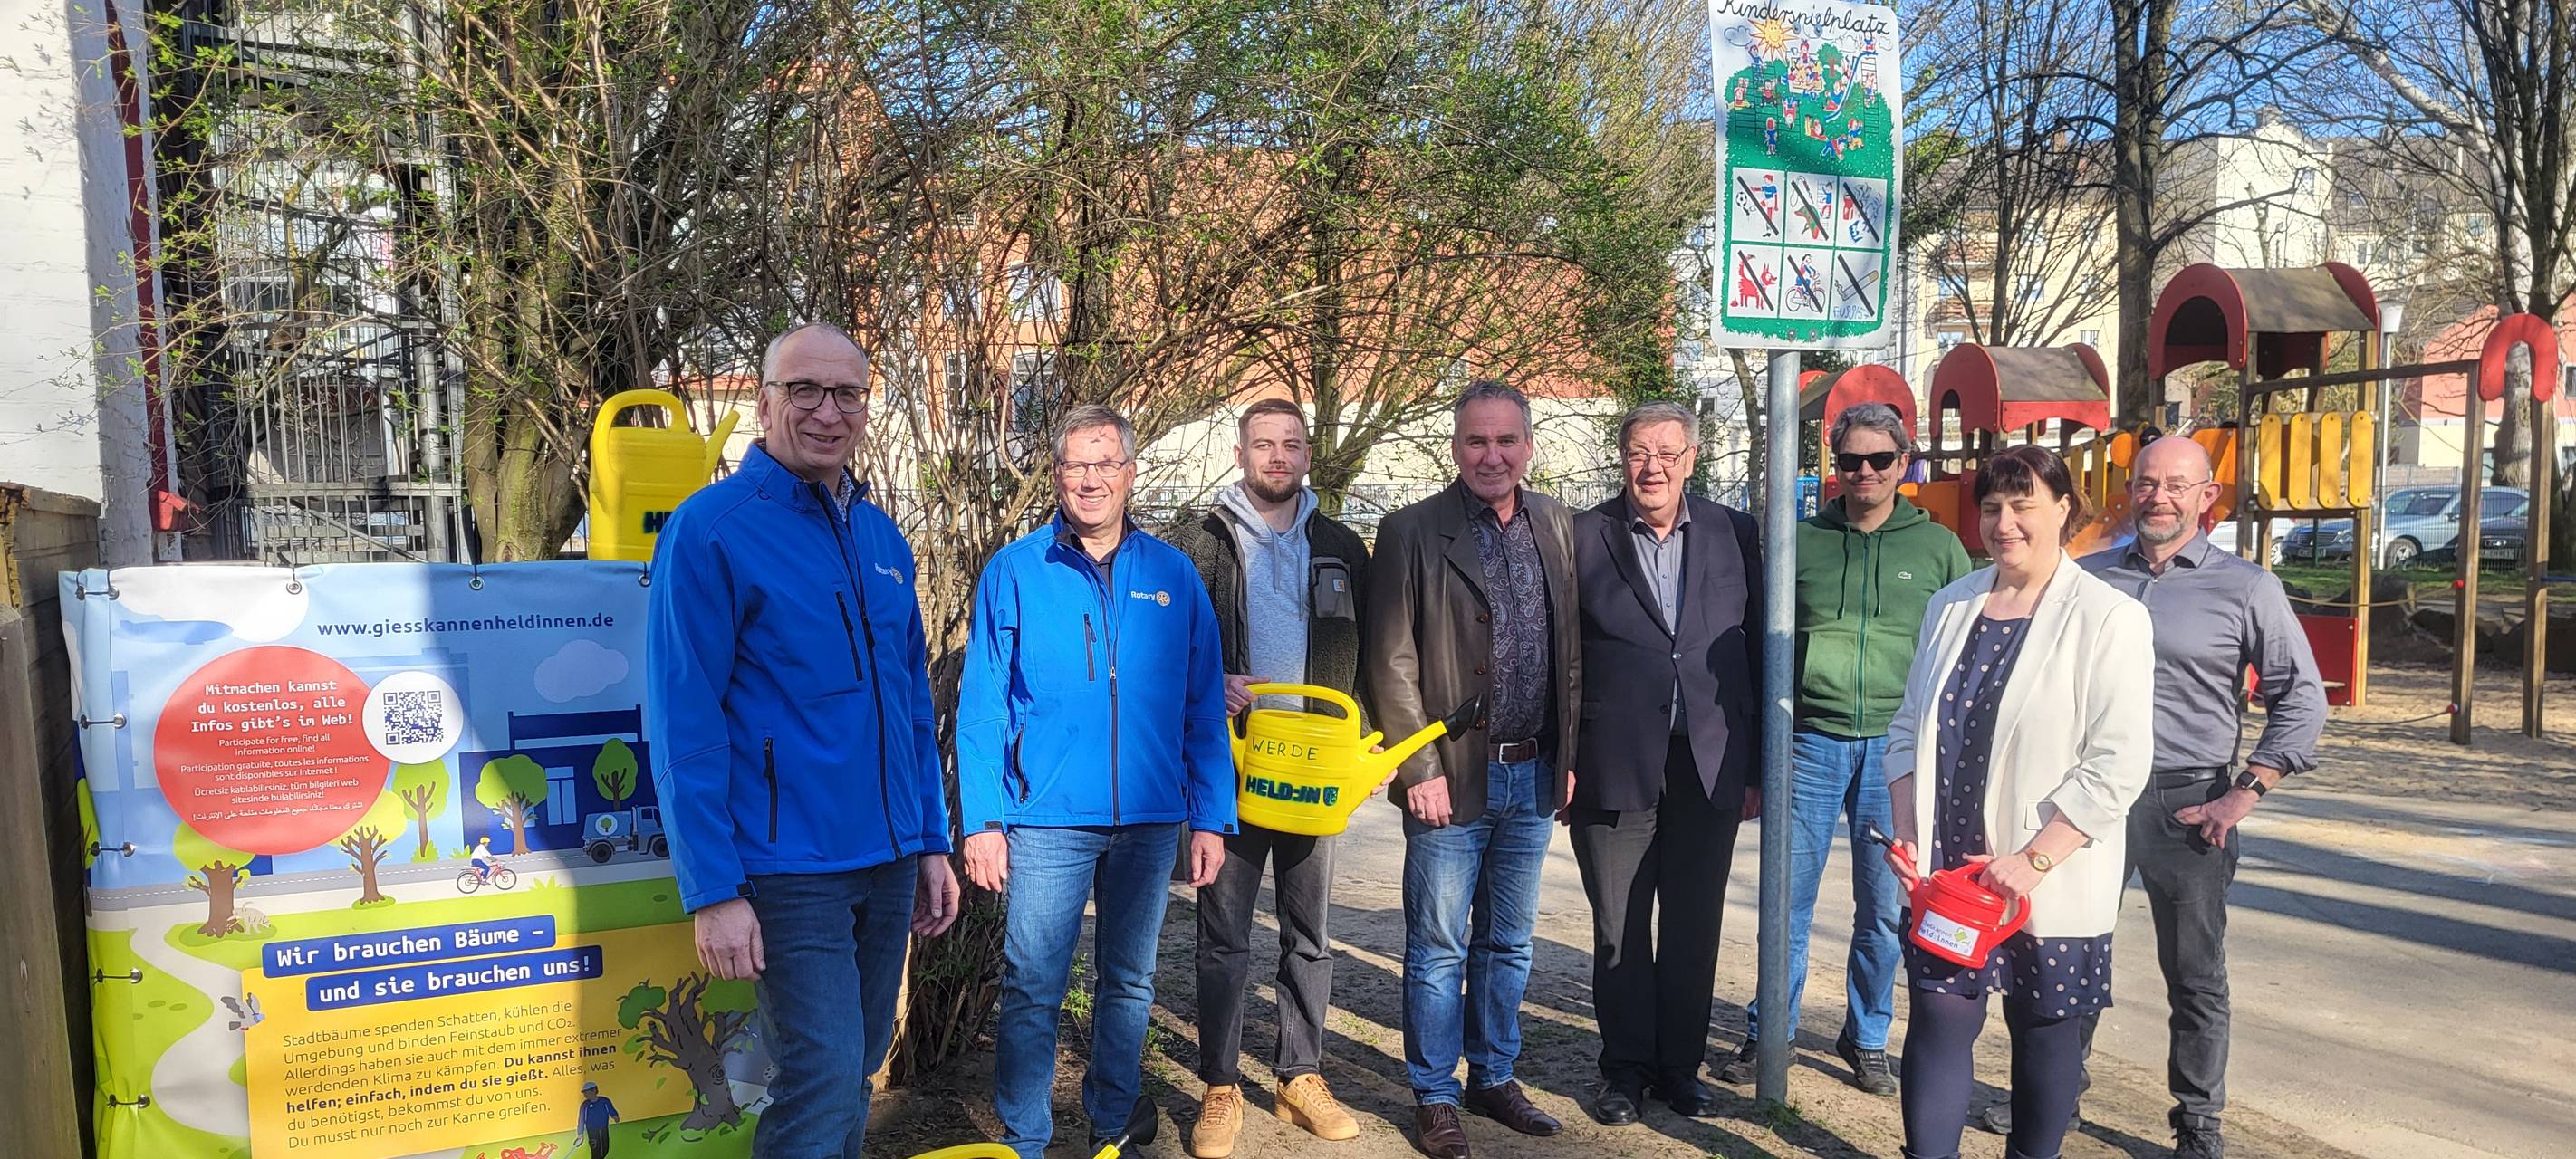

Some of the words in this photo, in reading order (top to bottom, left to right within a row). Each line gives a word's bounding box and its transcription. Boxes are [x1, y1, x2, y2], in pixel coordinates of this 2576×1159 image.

[1717, 0, 1890, 35] Kinderspielplatz
[1130, 590, 1156, 601] Rotary
[317, 613, 614, 637] www.giesskannenheldinnen.de
[206, 682, 281, 696] Mitmachen
[288, 680, 337, 693] kannst
[198, 702, 216, 714] du
[224, 698, 305, 713] kostenlos,
[313, 696, 346, 708] alle
[191, 721, 233, 733] Infos
[298, 715, 315, 727] im
[322, 714, 353, 725] Web!
[218, 736, 265, 748] Participate
[266, 735, 278, 744] for
[281, 734, 301, 744] free,
[302, 733, 318, 742] find
[320, 733, 331, 742] all
[235, 745, 285, 756] information
[287, 744, 315, 753] online!
[1251, 736, 1320, 761] WERDE
[180, 762, 235, 773] Participation
[236, 760, 272, 771] gratuite,
[274, 759, 303, 768] toutes
[303, 757, 315, 766] les
[317, 754, 370, 765] informations
[215, 773, 234, 781] sont
[235, 771, 284, 781] disponibles
[284, 770, 298, 778] sur
[194, 786, 228, 797] Ücretsiz
[290, 781, 307, 790] tüm
[309, 779, 340, 790] bilgileri
[341, 778, 359, 786] web
[231, 793, 269, 804] sitesinde
[271, 790, 324, 801] bulabilirsiniz!
[276, 947, 319, 967] Wir
[333, 935, 442, 962] brauchen
[455, 926, 520, 949] Bäume
[319, 982, 360, 1002] und
[374, 975, 415, 996] sie
[428, 963, 531, 991] brauchen
[543, 955, 590, 977] uns!
[283, 1029, 370, 1047] Stadtbäume
[374, 1019, 434, 1037] spenden
[437, 1011, 501, 1028] Schatten,
[505, 1003, 549, 1019] kühlen
[552, 1001, 572, 1012] die
[284, 1046, 363, 1064] Umgebung
[368, 1040, 394, 1054] und
[399, 1035, 446, 1049] binden
[450, 1025, 515, 1042] Feinstaub
[519, 1020, 543, 1034] und
[284, 1063, 356, 1081] Allerdings
[359, 1056, 402, 1072] haben
[405, 1054, 424, 1066] sie
[427, 1048, 458, 1062] auch
[462, 1045, 485, 1058] mit
[487, 1040, 515, 1055] dem
[520, 1036, 561, 1050] immer
[564, 1028, 622, 1045] extremer
[285, 1077, 369, 1097] werdenden
[373, 1071, 412, 1086] Klima
[416, 1068, 432, 1080] zu
[436, 1060, 500, 1078] kämpfen.
[505, 1057, 524, 1068] Du
[528, 1048, 575, 1065] kannst
[579, 1044, 617, 1058] ihnen
[286, 1097, 341, 1114] helfen;
[345, 1087, 407, 1106] einfach,
[410, 1082, 456, 1097] indem
[459, 1078, 477, 1090] du
[482, 1074, 502, 1087] sie
[506, 1068, 549, 1087] gießt.
[552, 1064, 587, 1078] Alles,
[590, 1059, 615, 1072] was
[287, 1118, 306, 1131] du
[311, 1107, 384, 1128] benötigst,
[389, 1096, 464, 1117] bekommst
[466, 1092, 483, 1106] du
[486, 1091, 512, 1103] von
[515, 1087, 543, 1099] uns.
[288, 1135, 309, 1149] Du
[313, 1129, 357, 1145] musst
[360, 1125, 385, 1138] nur
[389, 1117, 423, 1134] noch
[427, 1116, 448, 1129] zur
[452, 1110, 495, 1125] Kanne
[498, 1102, 551, 1120] greifen.
